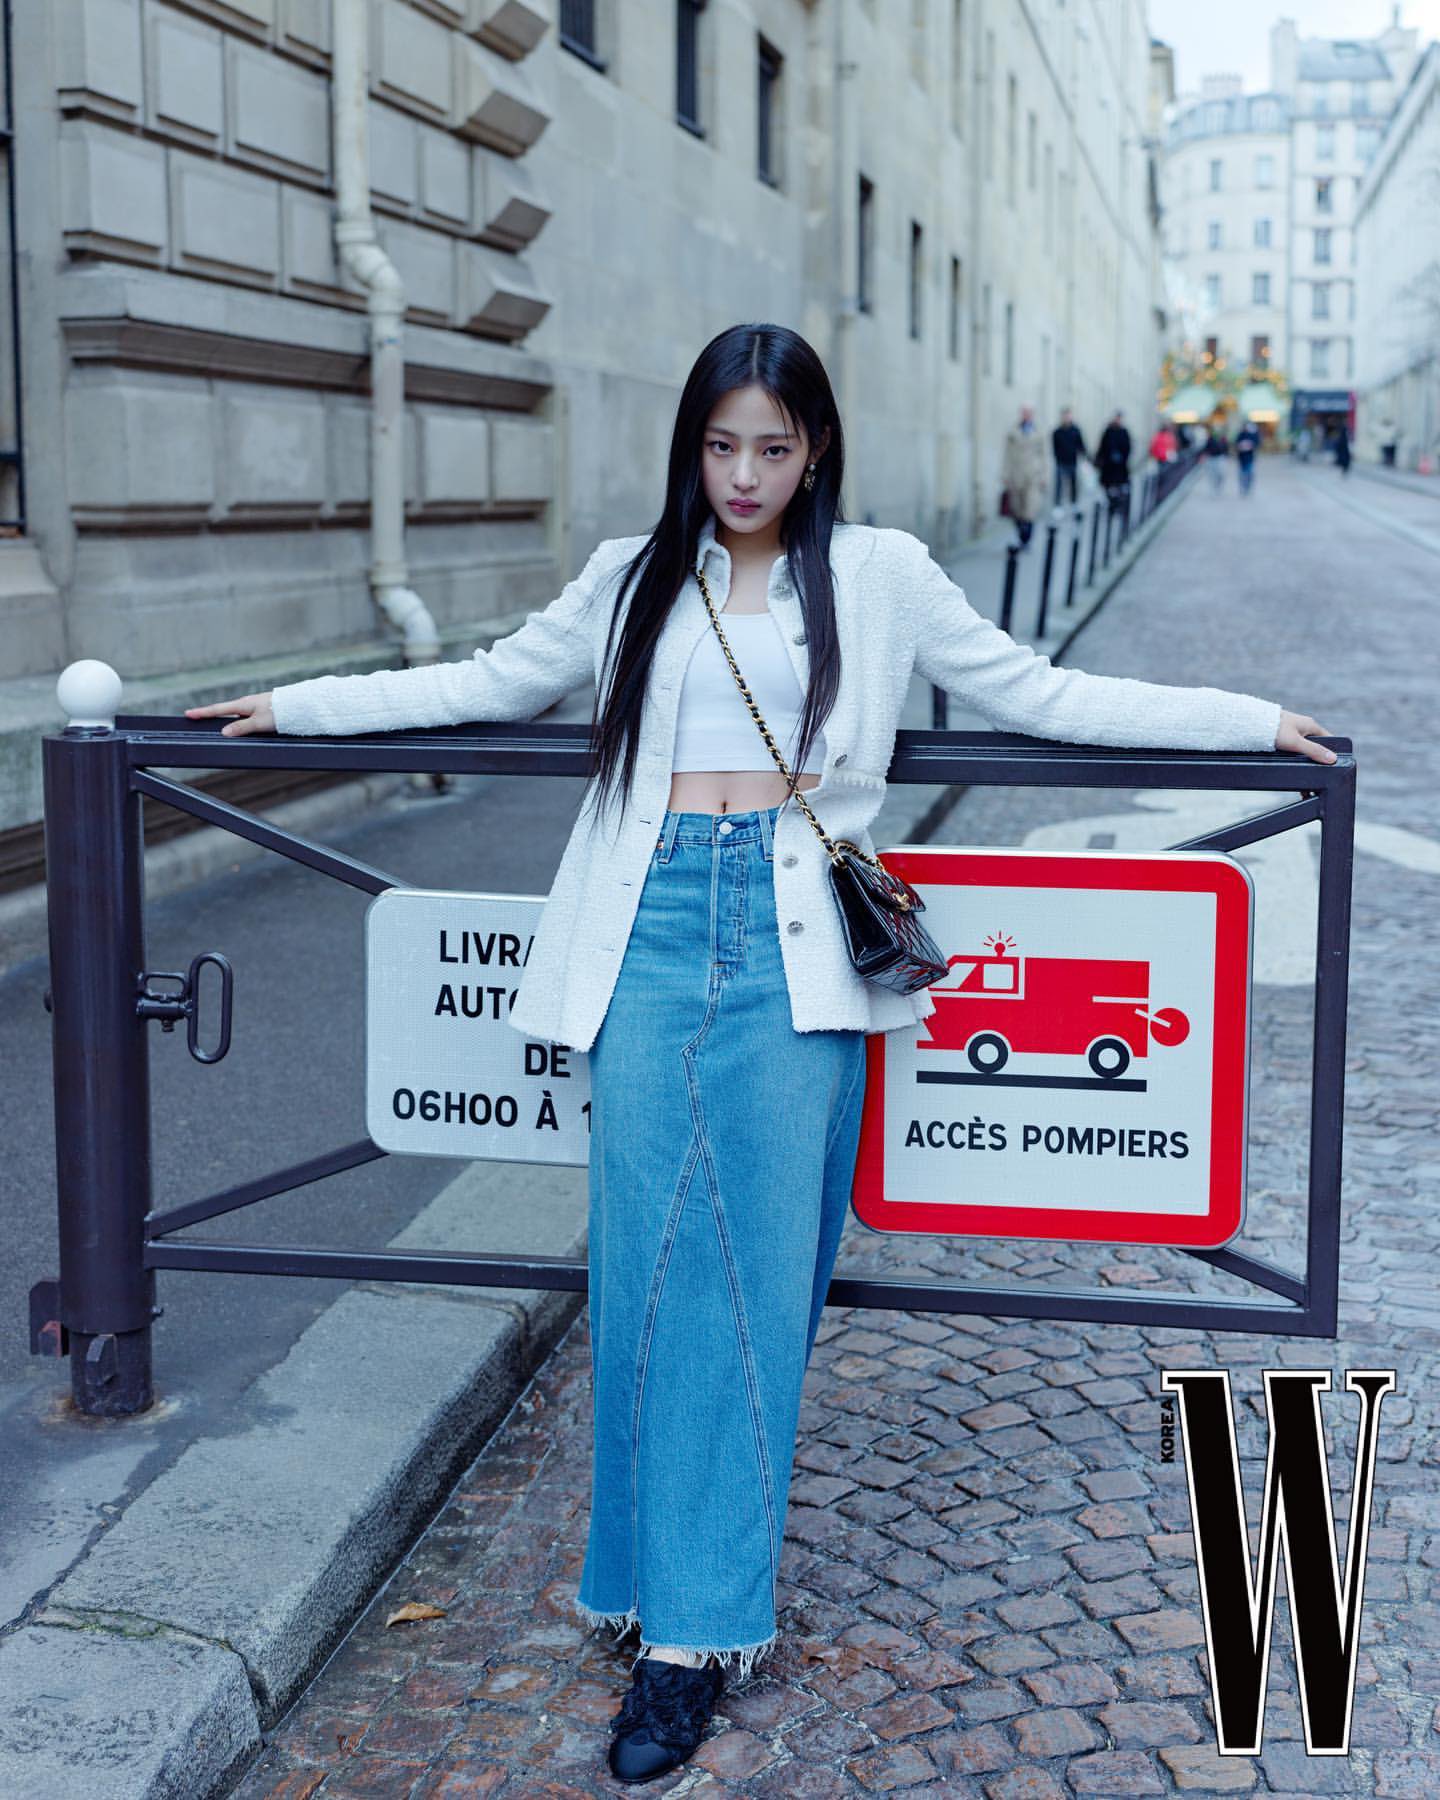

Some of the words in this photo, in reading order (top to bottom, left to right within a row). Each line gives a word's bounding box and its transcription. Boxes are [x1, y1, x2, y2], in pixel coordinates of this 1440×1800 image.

[524, 1043, 571, 1078] DE
[392, 1088, 518, 1128] 06H00
[536, 1090, 559, 1130] À
[905, 1116, 1007, 1151] ACCÈS
[1022, 1125, 1189, 1158] POMPIERS
